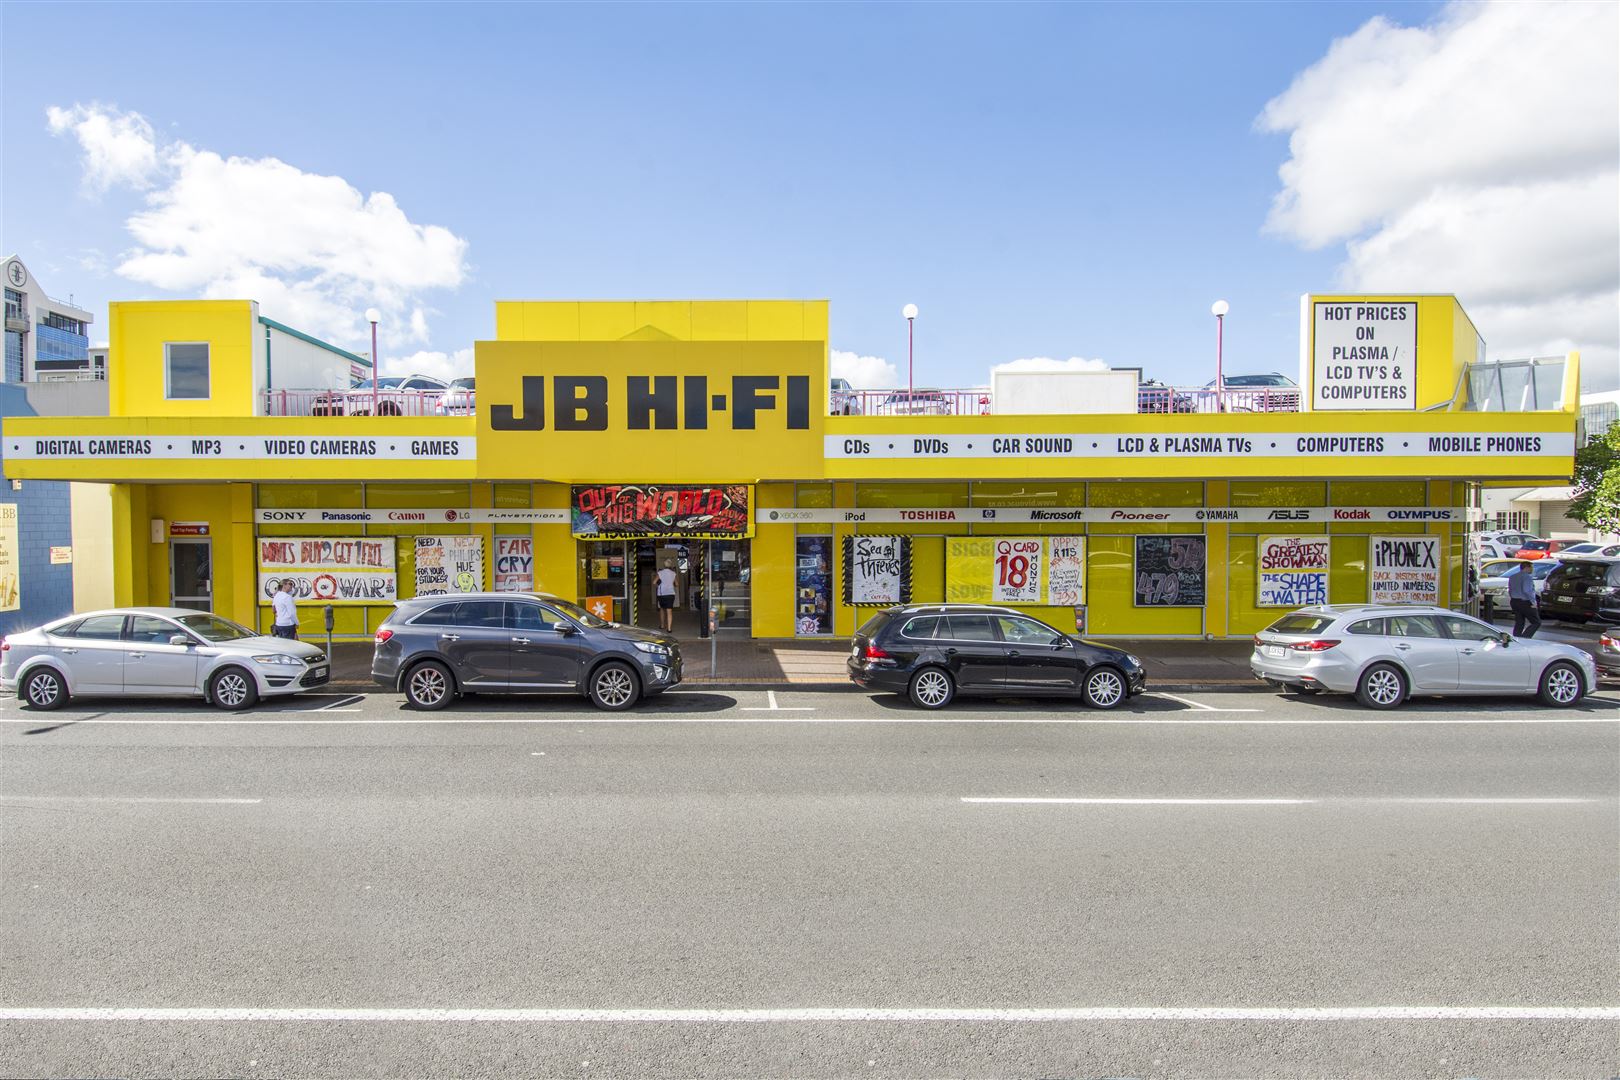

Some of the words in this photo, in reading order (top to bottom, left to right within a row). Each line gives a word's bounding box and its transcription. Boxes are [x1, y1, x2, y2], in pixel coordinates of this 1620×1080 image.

[1325, 307, 1352, 320] HOT
[1357, 307, 1407, 320] PRICES
[1356, 327, 1375, 340] ON
[1333, 346, 1389, 360] PLASMA
[1326, 366, 1353, 379] LCD
[1358, 366, 1387, 379] TV'S
[1392, 366, 1402, 379] &
[1321, 385, 1407, 399] COMPUTERS
[490, 375, 608, 431] JB
[627, 375, 810, 430] HI-FI
[36, 440, 84, 455] DIGITAL
[89, 440, 152, 455] CAMERAS
[192, 440, 222, 455] MP3
[265, 440, 306, 455] VIDEO
[310, 440, 376, 455] CAMERAS
[411, 440, 459, 455] GAMES
[844, 439, 870, 454] CDs
[913, 438, 949, 454] DVDs
[992, 438, 1021, 453] CAR
[1025, 438, 1073, 453] SOUND
[1117, 437, 1144, 453] LCD
[1149, 437, 1160, 453] &
[1164, 437, 1222, 453] PLASMA
[1227, 437, 1252, 453] TVs
[1296, 437, 1384, 452] COMPUTERS
[1429, 437, 1481, 452] MOBILE
[1486, 437, 1541, 452] PHONES
[579, 486, 622, 512] OUT
[635, 489, 723, 521] WORLD
[263, 512, 306, 520] SONY
[322, 512, 371, 521] Panasonic
[388, 511, 425, 520] Canon
[593, 504, 634, 524] THIS
[845, 512, 866, 521] iPod
[900, 511, 956, 520] TOSHIBA
[1030, 510, 1082, 520] Microsoft
[1111, 511, 1171, 520] Pioneer
[1206, 511, 1239, 519] YAMAHA
[1268, 510, 1310, 519] ASUS
[1334, 509, 1371, 519] Kodak
[1387, 510, 1451, 519] OLYMPUS
[710, 517, 743, 531] SALE
[418, 538, 435, 547] NEED
[436, 538, 443, 547] A
[454, 537, 476, 548] NEW
[499, 539, 532, 555] FAR
[856, 538, 883, 557] Sea
[997, 541, 1012, 556] Q
[1013, 542, 1040, 553] CARD
[1053, 537, 1079, 549] OPPO
[1284, 538, 1301, 546] THE
[334, 541, 354, 564] GET
[353, 541, 362, 565] 1
[449, 549, 481, 561] PHILIPS
[1267, 543, 1329, 559] GREATEST
[456, 562, 475, 573] HUE
[498, 557, 533, 574] CRY
[1262, 554, 1328, 570] SHOWMAN
[417, 567, 429, 576] FOR
[429, 567, 446, 576] YOUR
[995, 555, 1030, 589] 18
[1373, 571, 1391, 580] BACK
[337, 577, 386, 599] WAR
[1136, 571, 1180, 605] 479
[1262, 574, 1280, 582] THE
[1280, 573, 1327, 590] SHAPE
[1373, 581, 1400, 591] LIMITED
[1402, 581, 1436, 592] NUMBERS
[1271, 590, 1326, 605] WATER
